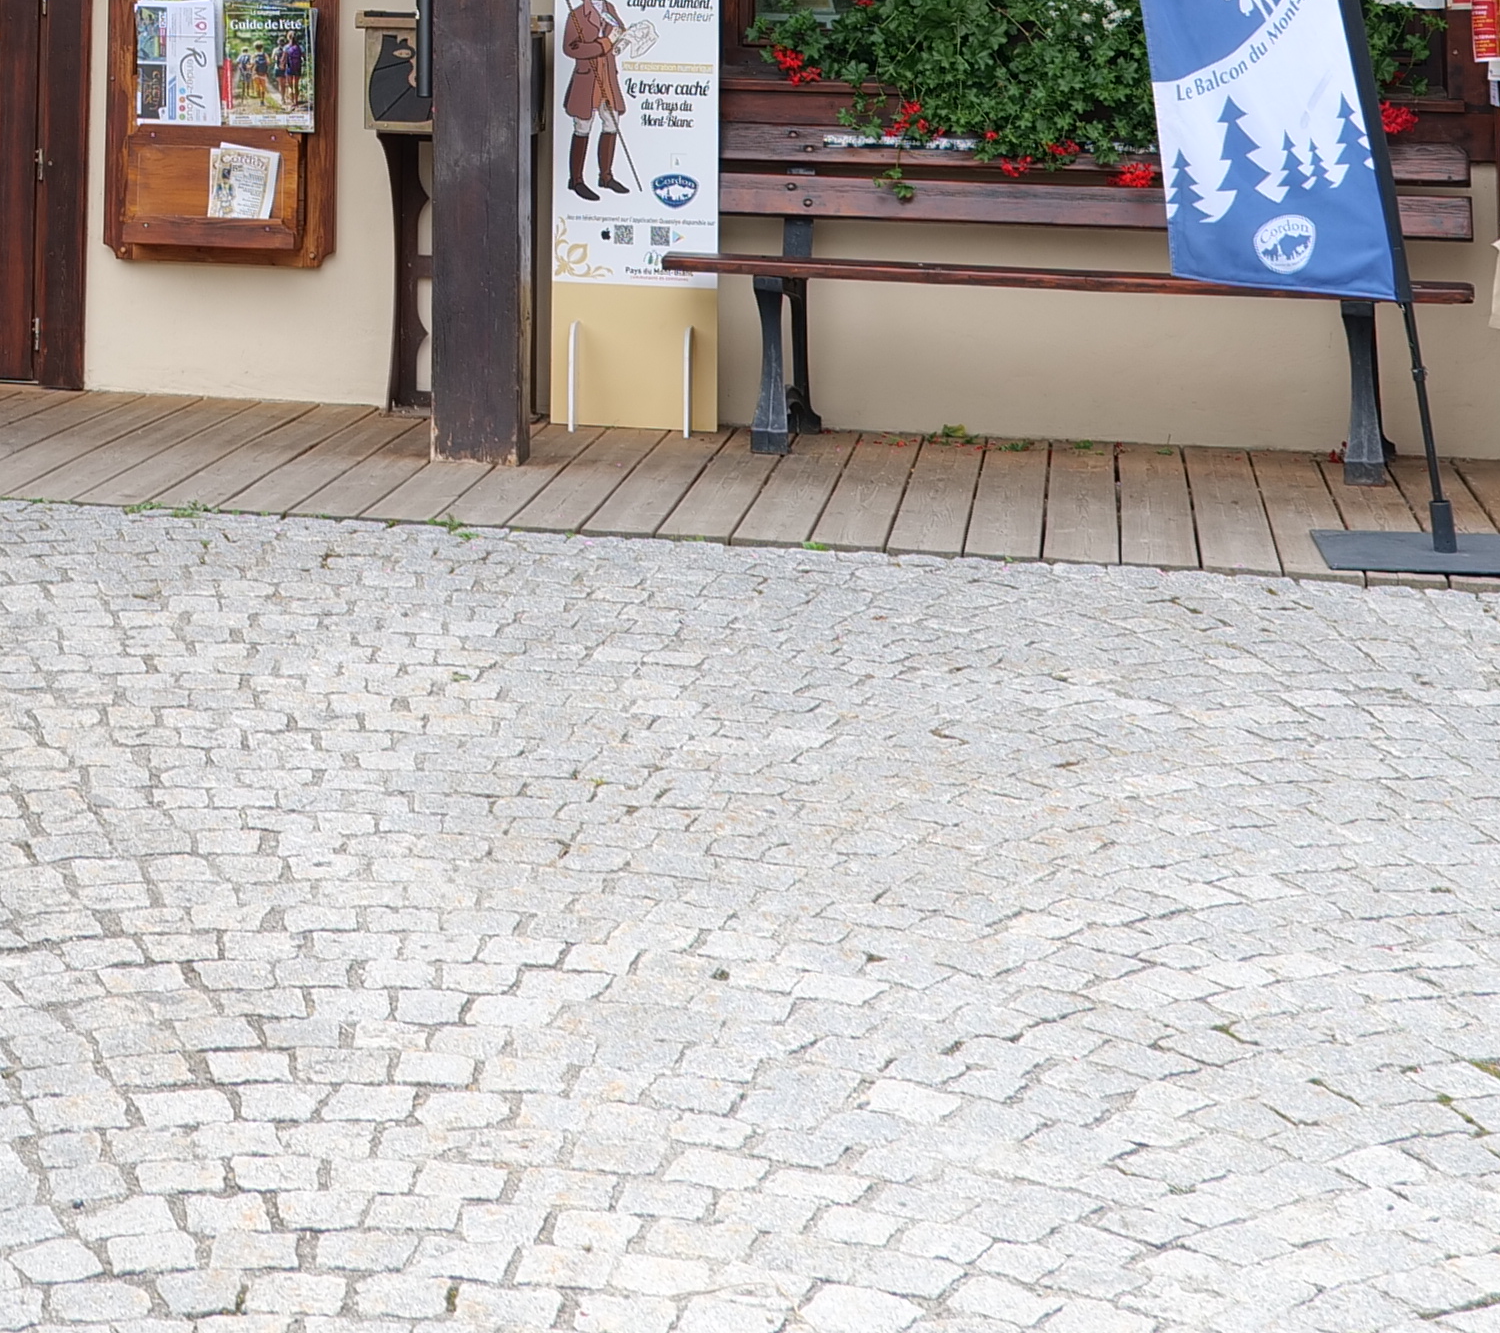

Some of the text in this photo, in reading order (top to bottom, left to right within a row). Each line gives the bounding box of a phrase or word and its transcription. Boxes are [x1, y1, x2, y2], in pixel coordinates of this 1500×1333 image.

[662, 9, 714, 23] Arpenteur
[230, 19, 302, 30] Guide de l'été
[1176, 84, 1193, 101] Le
[1194, 60, 1249, 96] Balcon
[1249, 41, 1269, 64] du
[624, 77, 710, 99] Le trésor caché
[641, 98, 693, 116] du Pays du
[641, 114, 694, 128] Mont-Blanc
[655, 175, 696, 189] Cordon
[1260, 219, 1309, 244] Cordon
[625, 266, 642, 276] Pays
